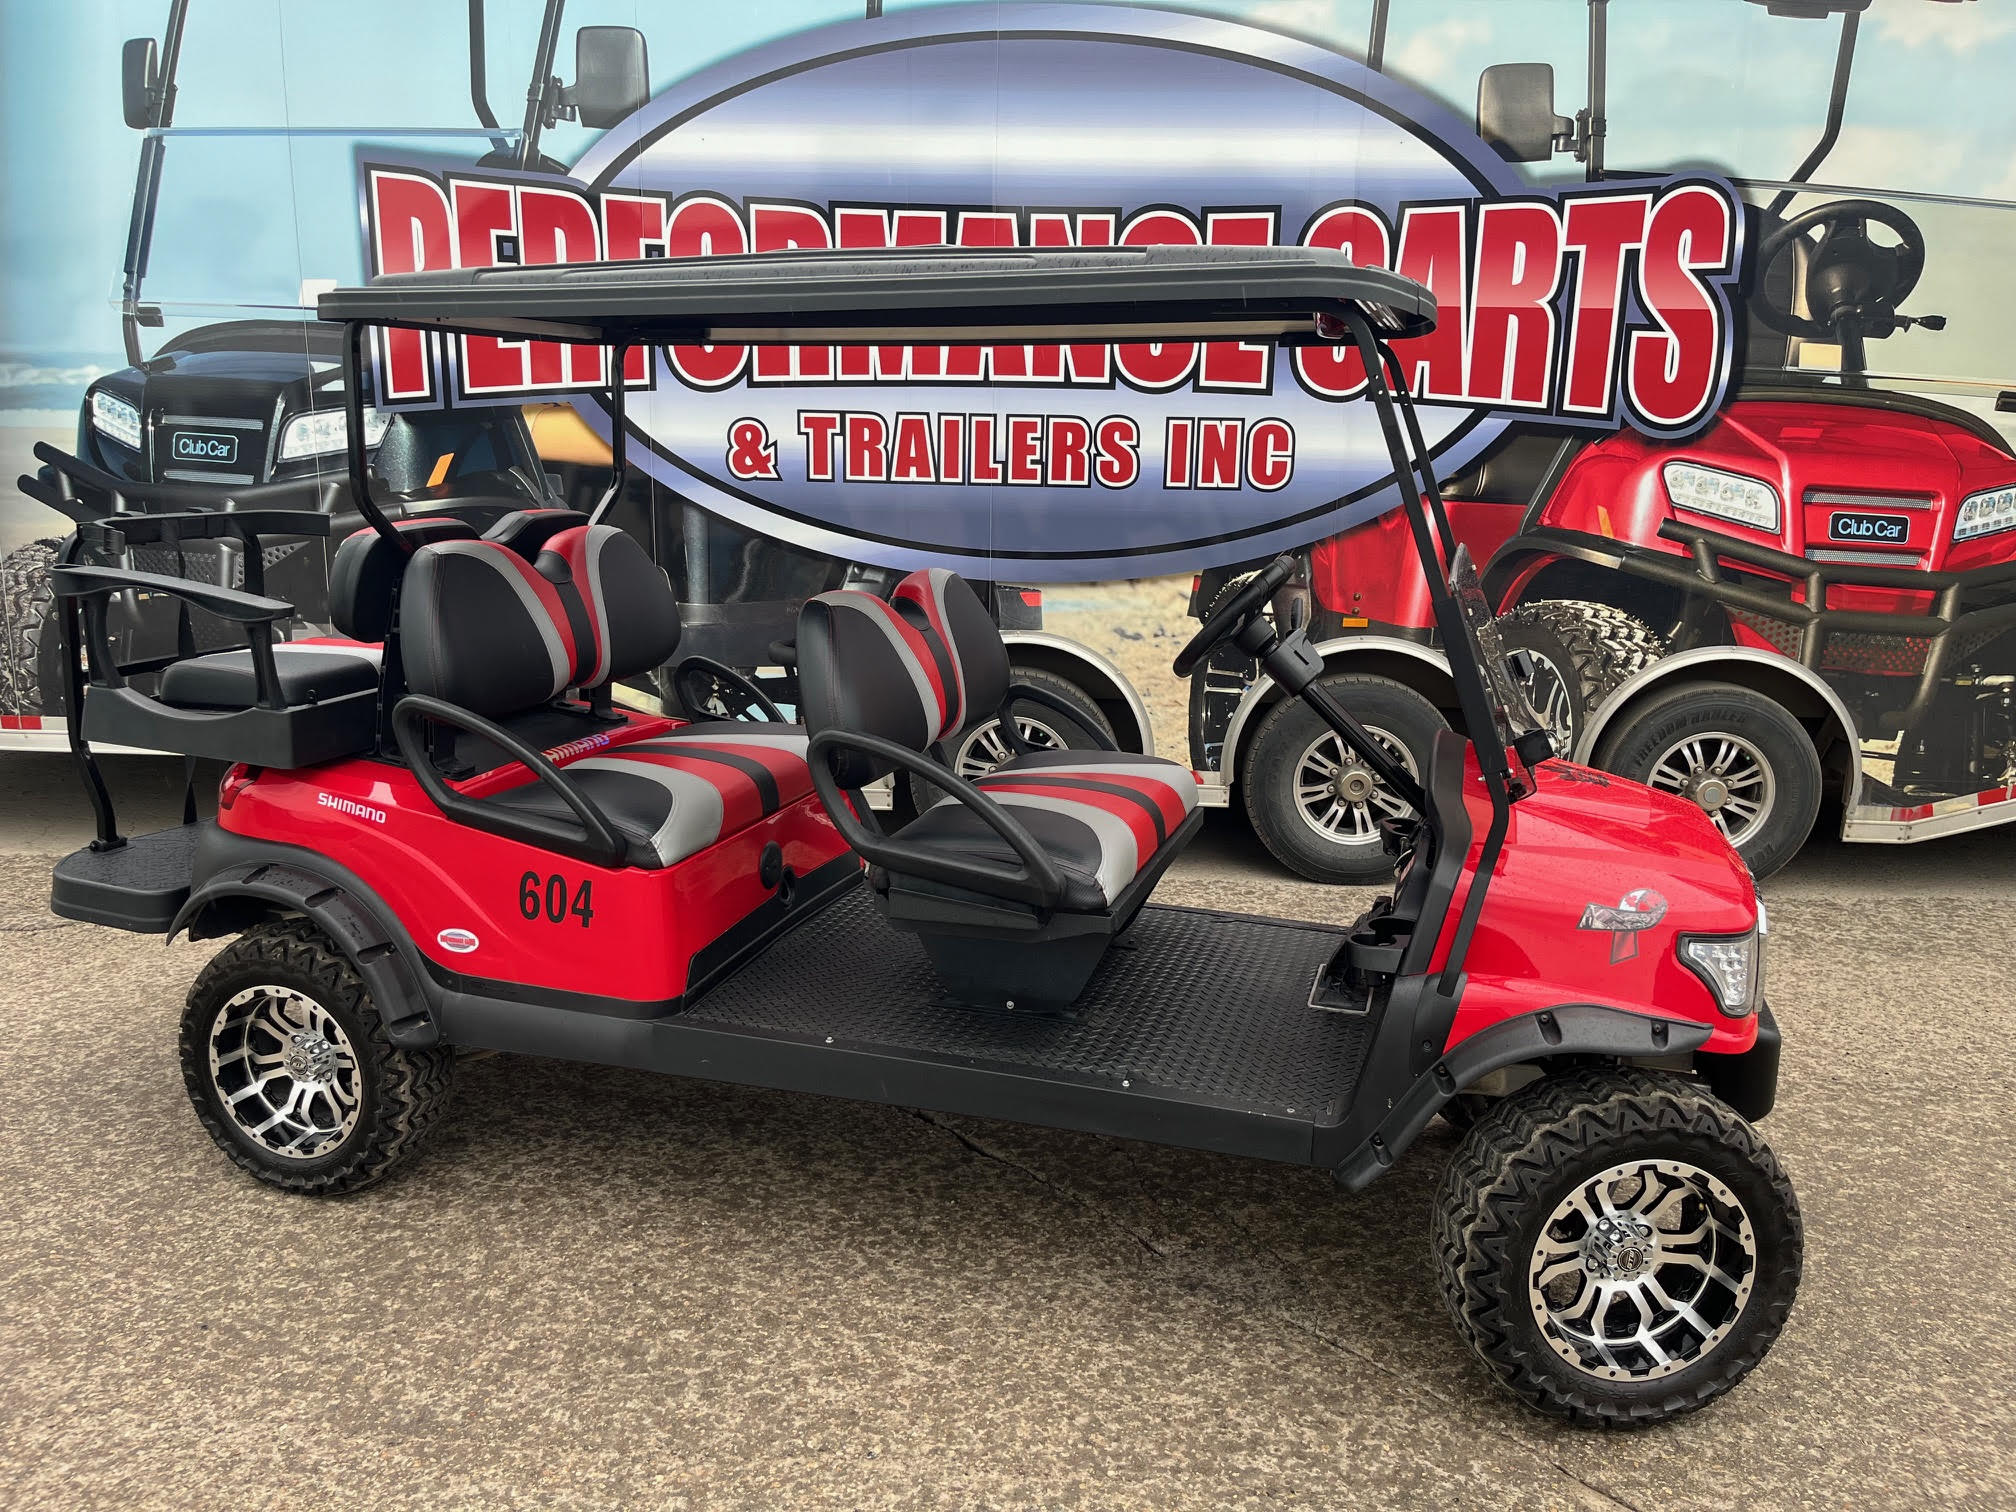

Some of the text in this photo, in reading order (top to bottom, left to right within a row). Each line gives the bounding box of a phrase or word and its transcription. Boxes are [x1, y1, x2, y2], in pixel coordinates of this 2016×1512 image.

[179, 438, 230, 457] Club Car
[730, 411, 1295, 491] & TRAILERS INC
[1838, 518, 1902, 538] Club Car
[541, 733, 610, 762] HIMANO
[317, 792, 386, 824] SHIMANO
[519, 870, 594, 928] 604
